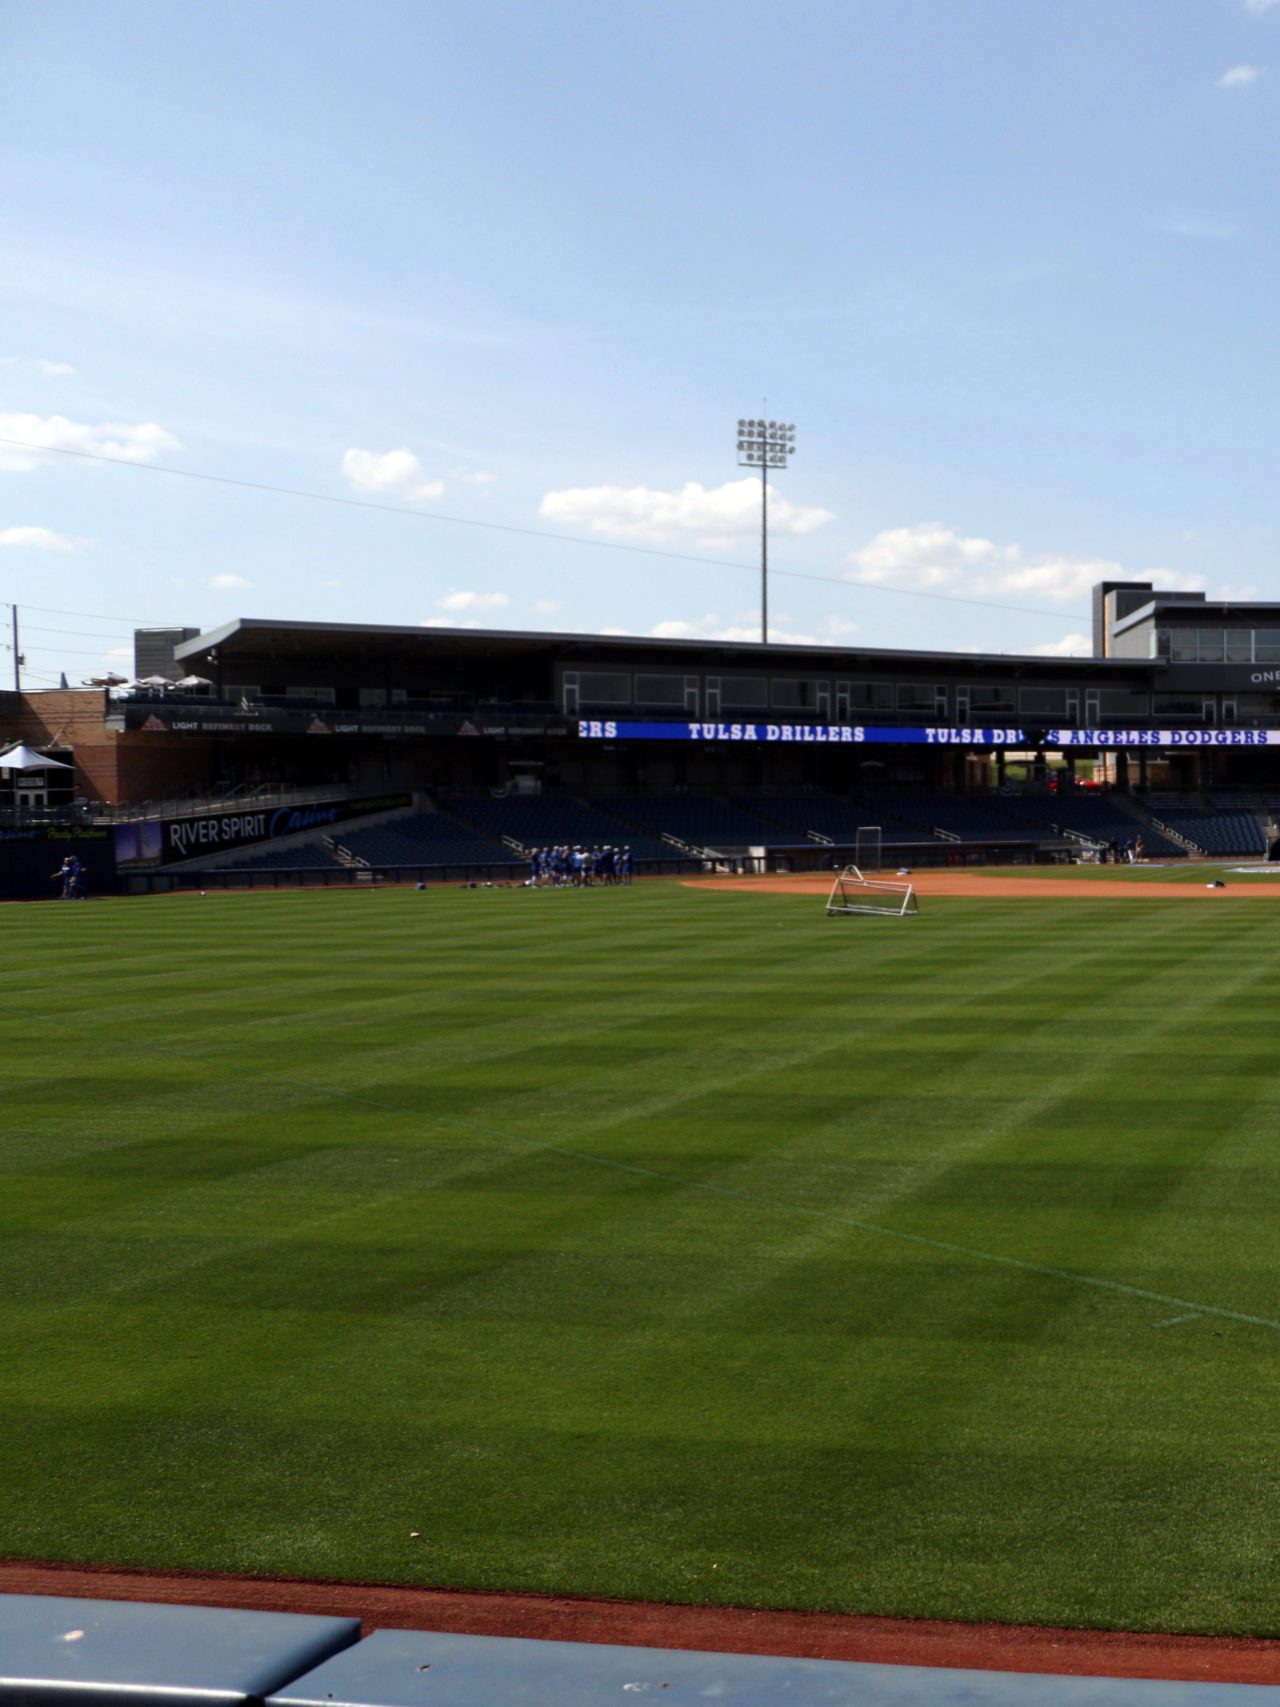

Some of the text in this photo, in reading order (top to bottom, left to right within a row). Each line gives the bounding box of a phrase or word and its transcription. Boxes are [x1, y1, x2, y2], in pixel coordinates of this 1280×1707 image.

[172, 721, 198, 730] LIGHT
[688, 722, 865, 742] TULSA DRILLERS
[925, 728, 985, 744] TULSA
[1070, 730, 1160, 745] ANGELES
[1171, 730, 1268, 745] DODGERS
[170, 804, 345, 855] RIVER SPIRIT Casino
